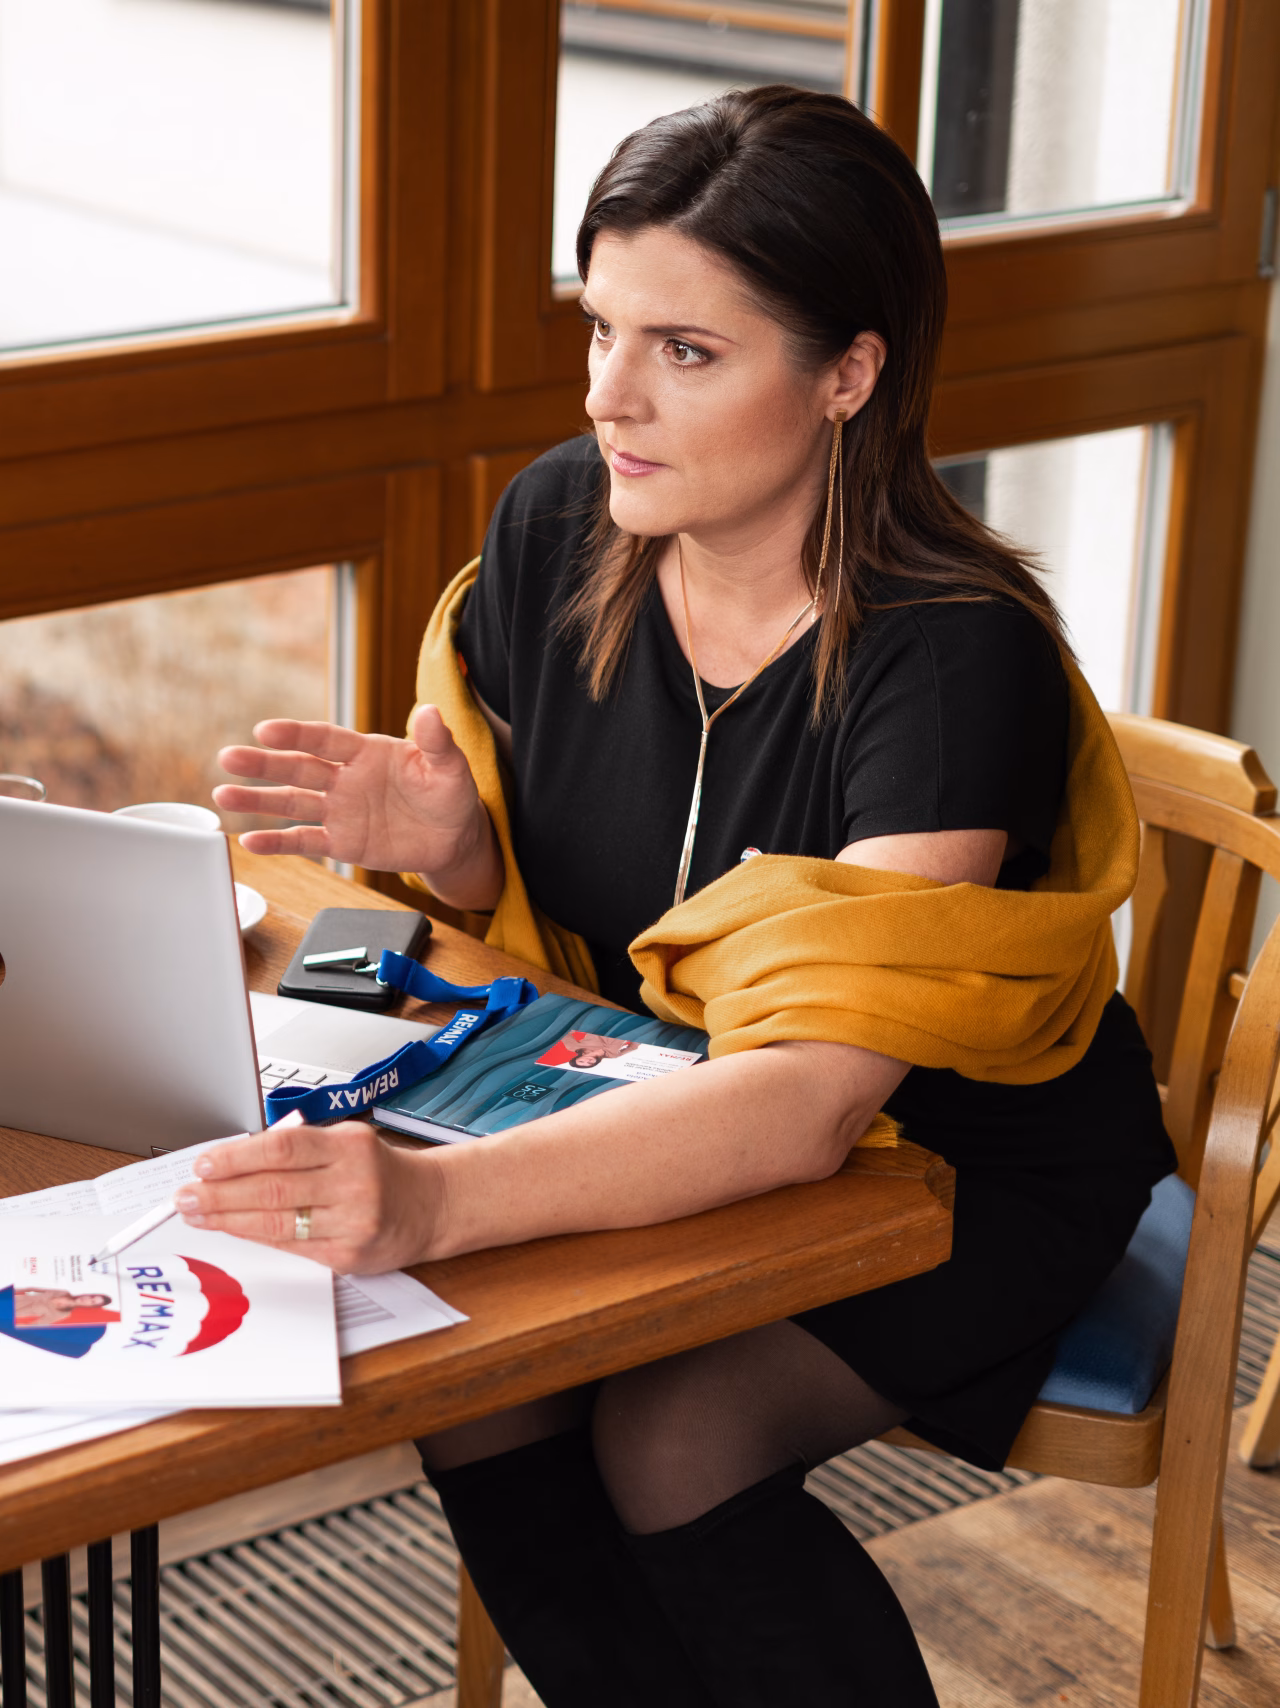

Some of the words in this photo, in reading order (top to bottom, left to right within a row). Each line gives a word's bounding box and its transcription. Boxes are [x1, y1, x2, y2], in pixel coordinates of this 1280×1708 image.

[434, 1013, 480, 1046] RE/MAX
[327, 1067, 400, 1111] RE/MAX
[121, 1266, 175, 1350] RE/MAX
